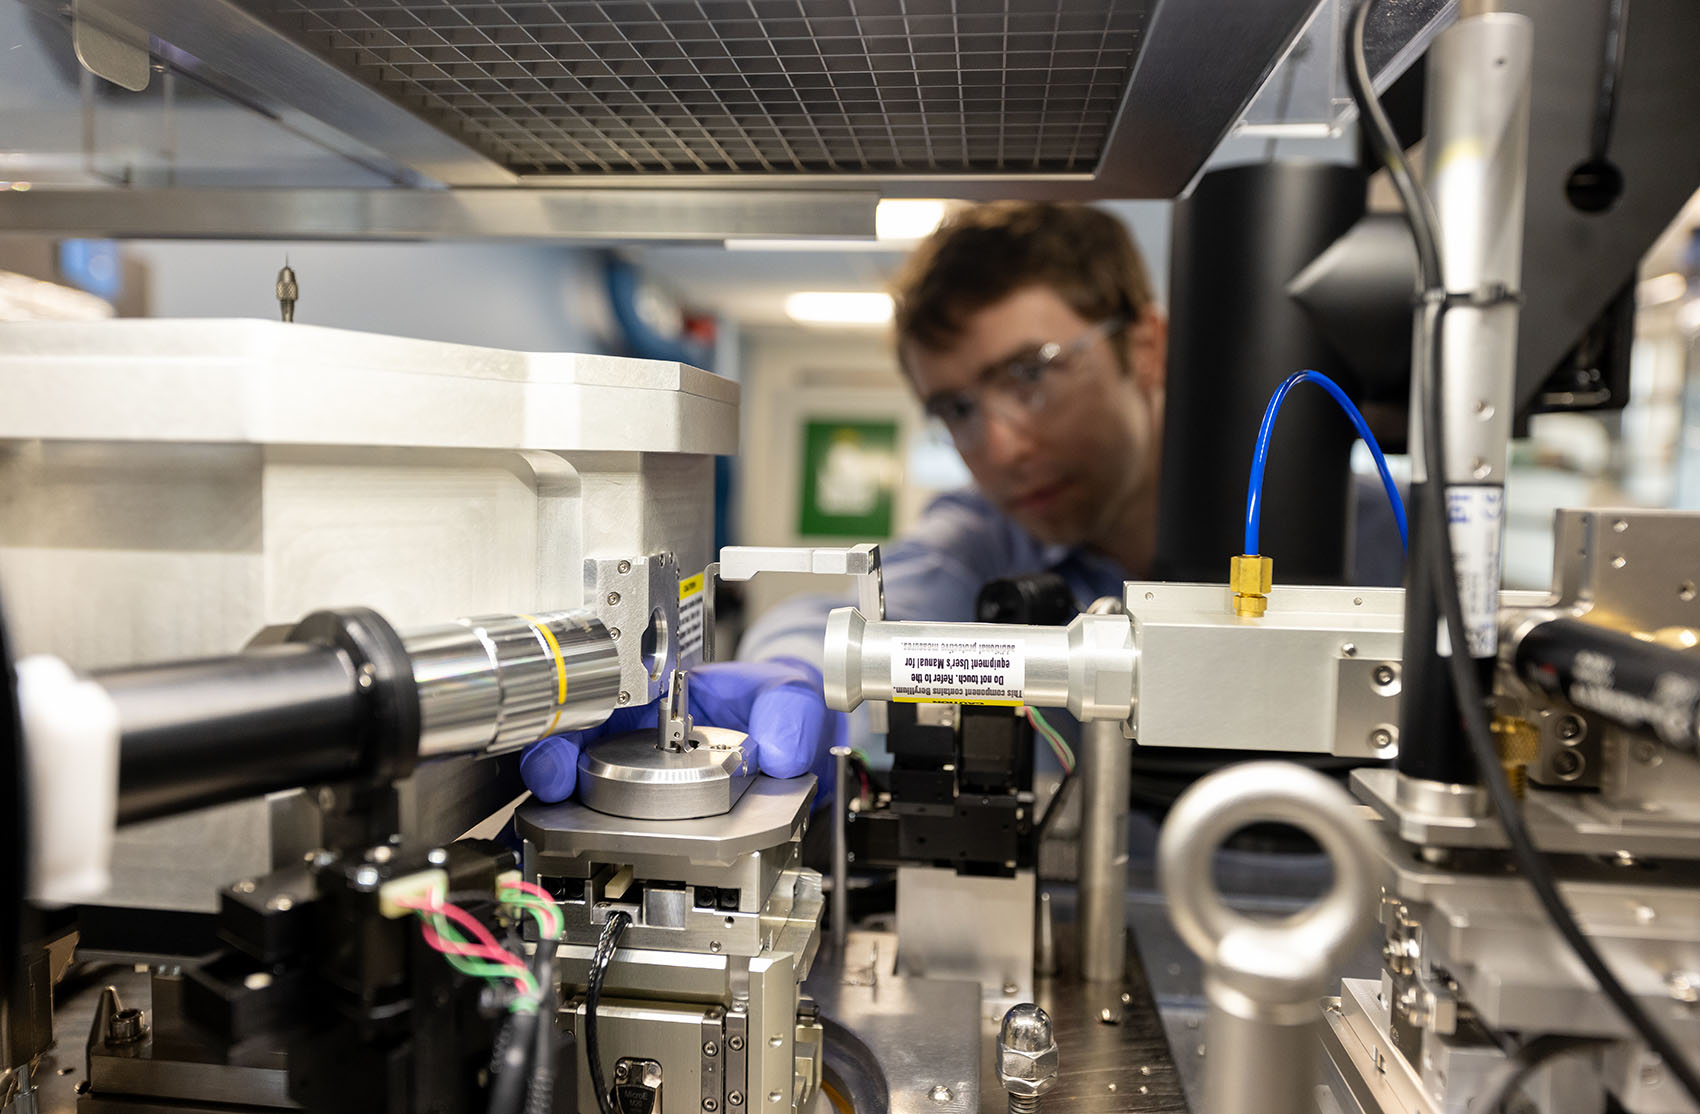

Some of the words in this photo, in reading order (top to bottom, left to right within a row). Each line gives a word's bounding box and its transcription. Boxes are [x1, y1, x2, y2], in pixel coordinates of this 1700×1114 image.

[940, 642, 977, 654] protective
[979, 643, 1016, 655] additional
[905, 657, 916, 668] for
[917, 658, 945, 669] Manual
[946, 658, 970, 669] User's
[971, 657, 1010, 670] equipment
[911, 673, 923, 683] the
[924, 673, 932, 683] to
[933, 673, 954, 684] Refer
[955, 674, 979, 685] touch.
[980, 675, 993, 685] not
[994, 675, 1004, 685] Do
[893, 685, 931, 695] Beryllium.
[932, 686, 964, 696] contains
[966, 687, 1006, 697] component
[1006, 689, 1023, 698] This
